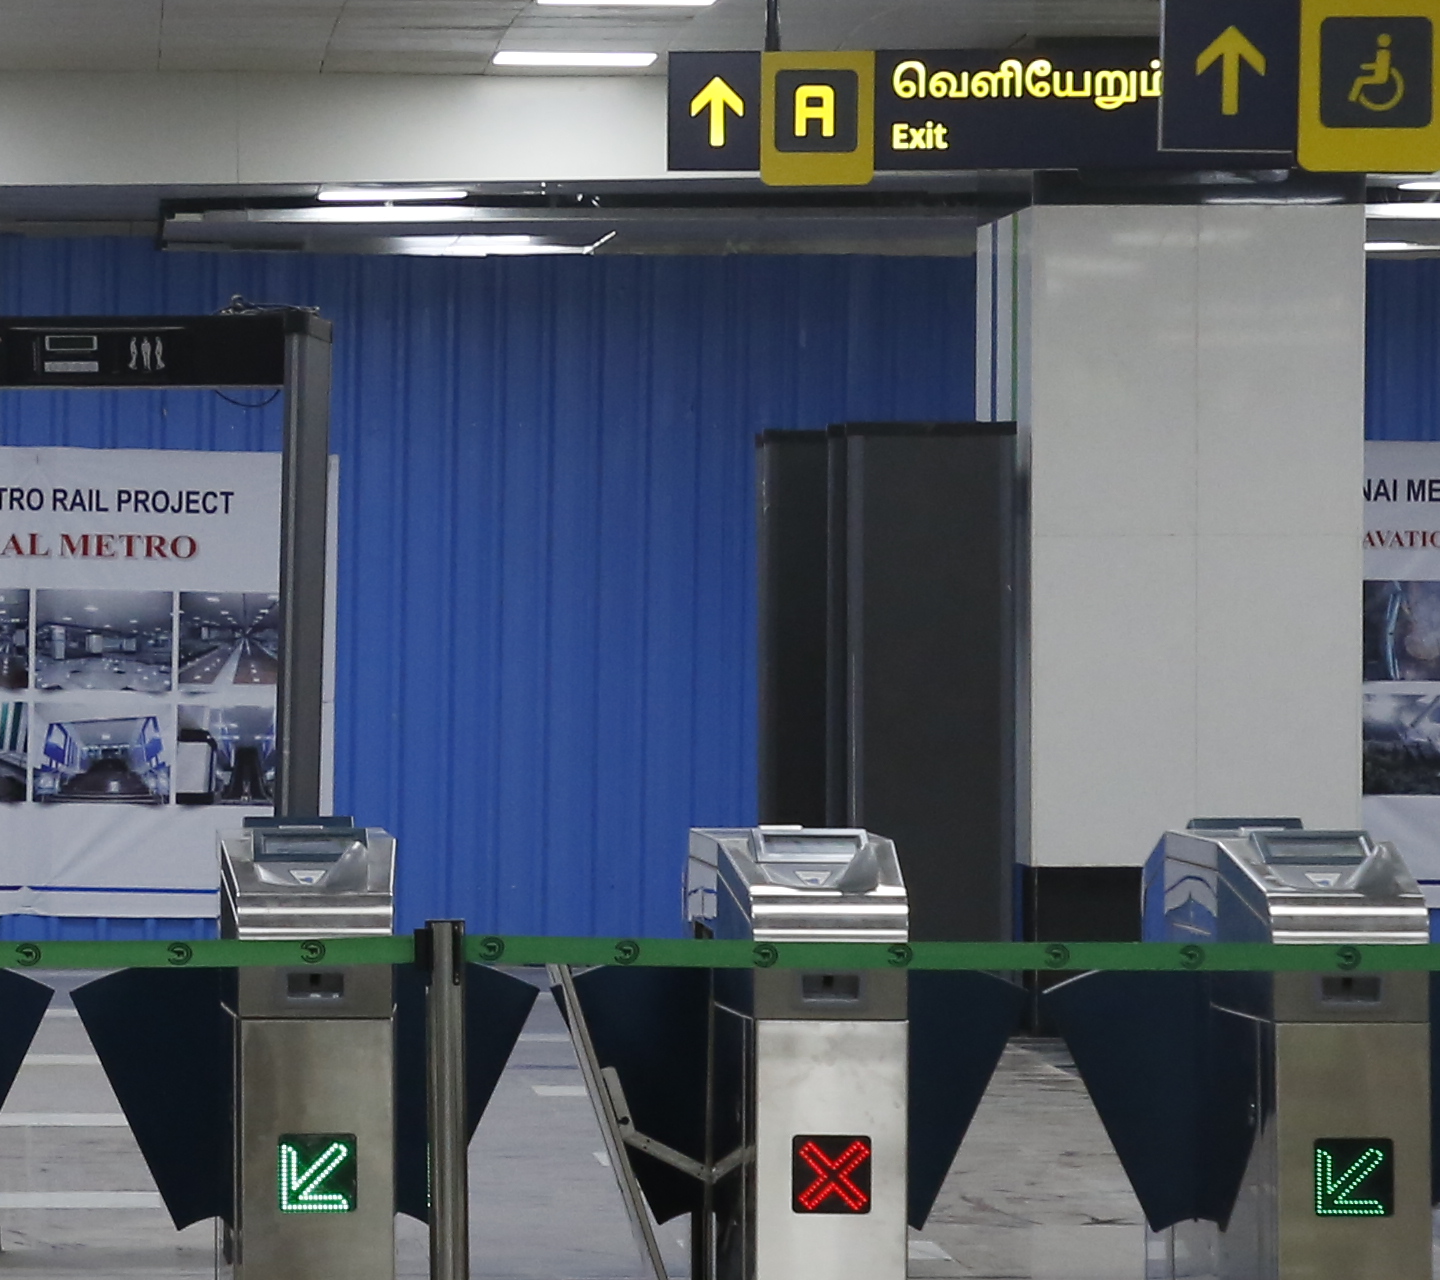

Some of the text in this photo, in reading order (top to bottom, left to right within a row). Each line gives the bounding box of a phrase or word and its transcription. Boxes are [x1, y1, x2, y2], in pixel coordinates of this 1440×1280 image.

[892, 59, 1164, 110] வெளியேறும்
[794, 85, 836, 138] A
[891, 121, 949, 152] Exit
[52, 487, 109, 512] RAIL
[116, 488, 235, 514] PROJECT
[59, 532, 198, 559] METRO
